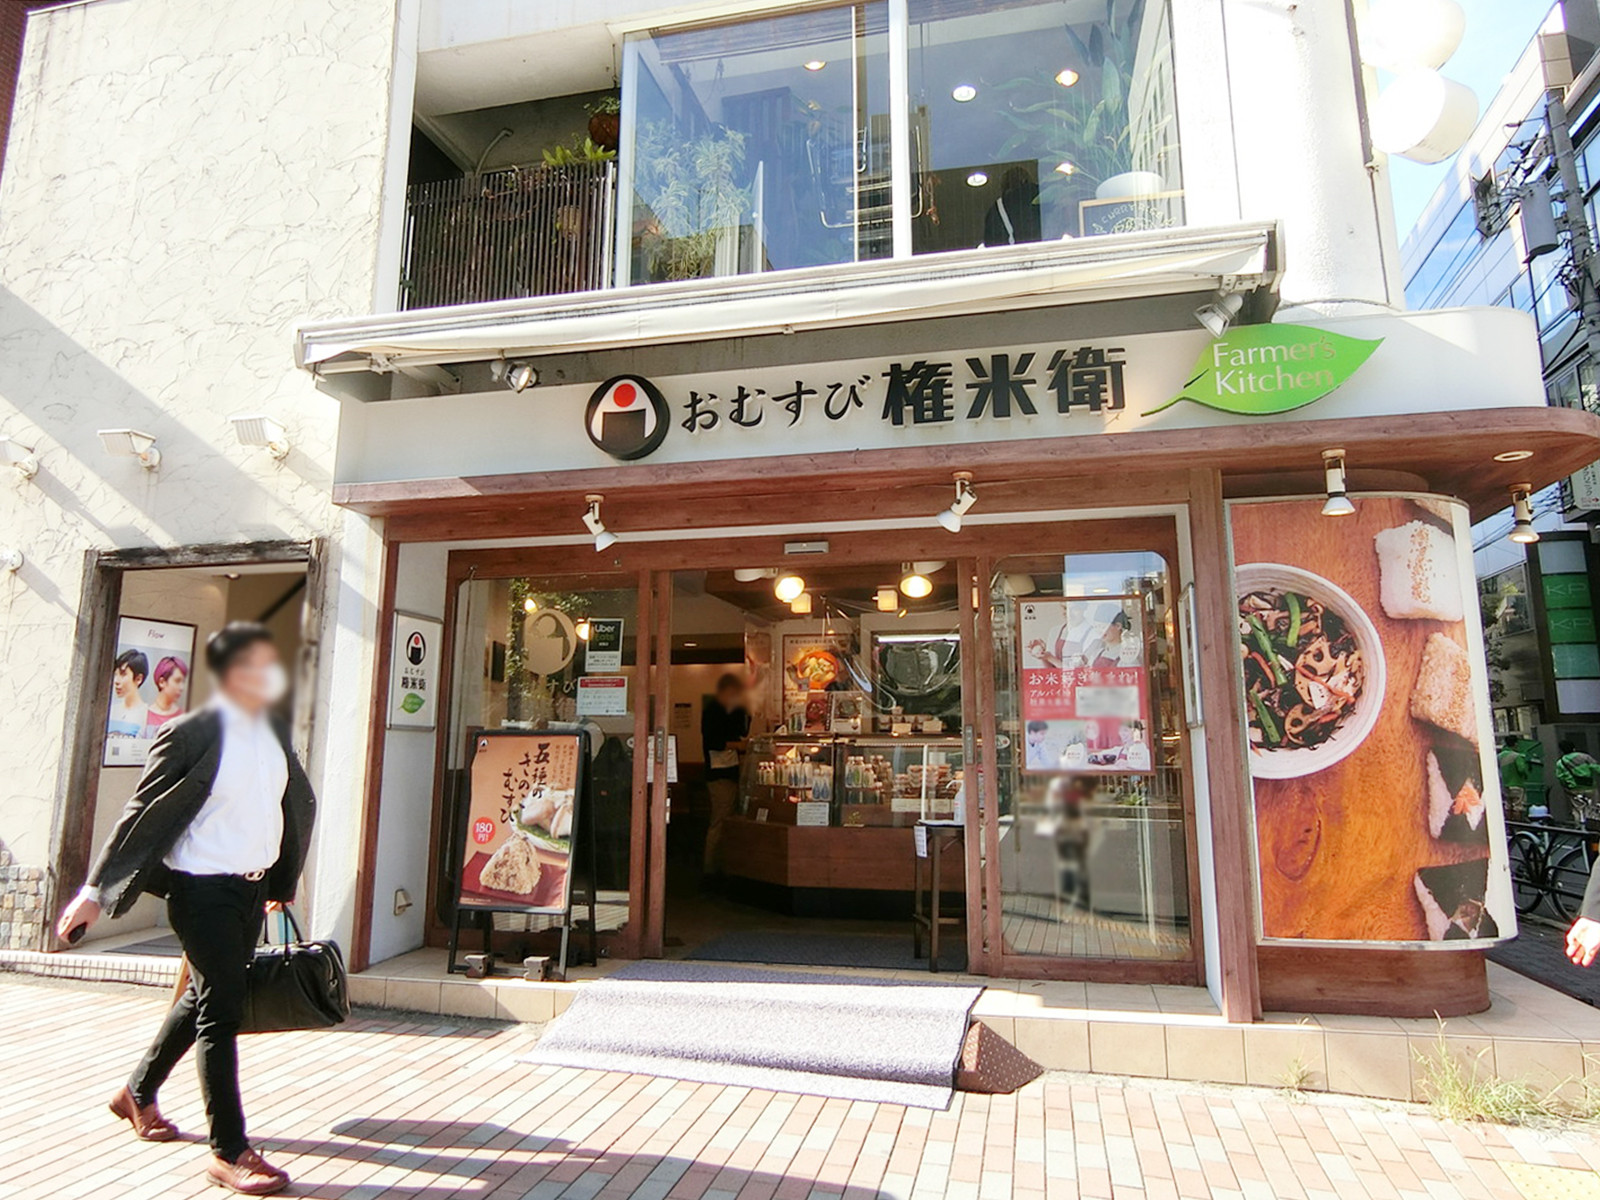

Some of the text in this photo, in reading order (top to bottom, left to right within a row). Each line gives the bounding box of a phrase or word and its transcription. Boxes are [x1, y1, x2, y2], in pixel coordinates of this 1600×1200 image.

[1213, 335, 1337, 368] Farmer's
[1215, 365, 1334, 396] Kitchen
[147, 629, 166, 639] Flow
[595, 623, 615, 633] Uber
[532, 743, 551, 799] 五種の
[500, 768, 519, 824] むすび
[475, 822, 493, 833] 180
